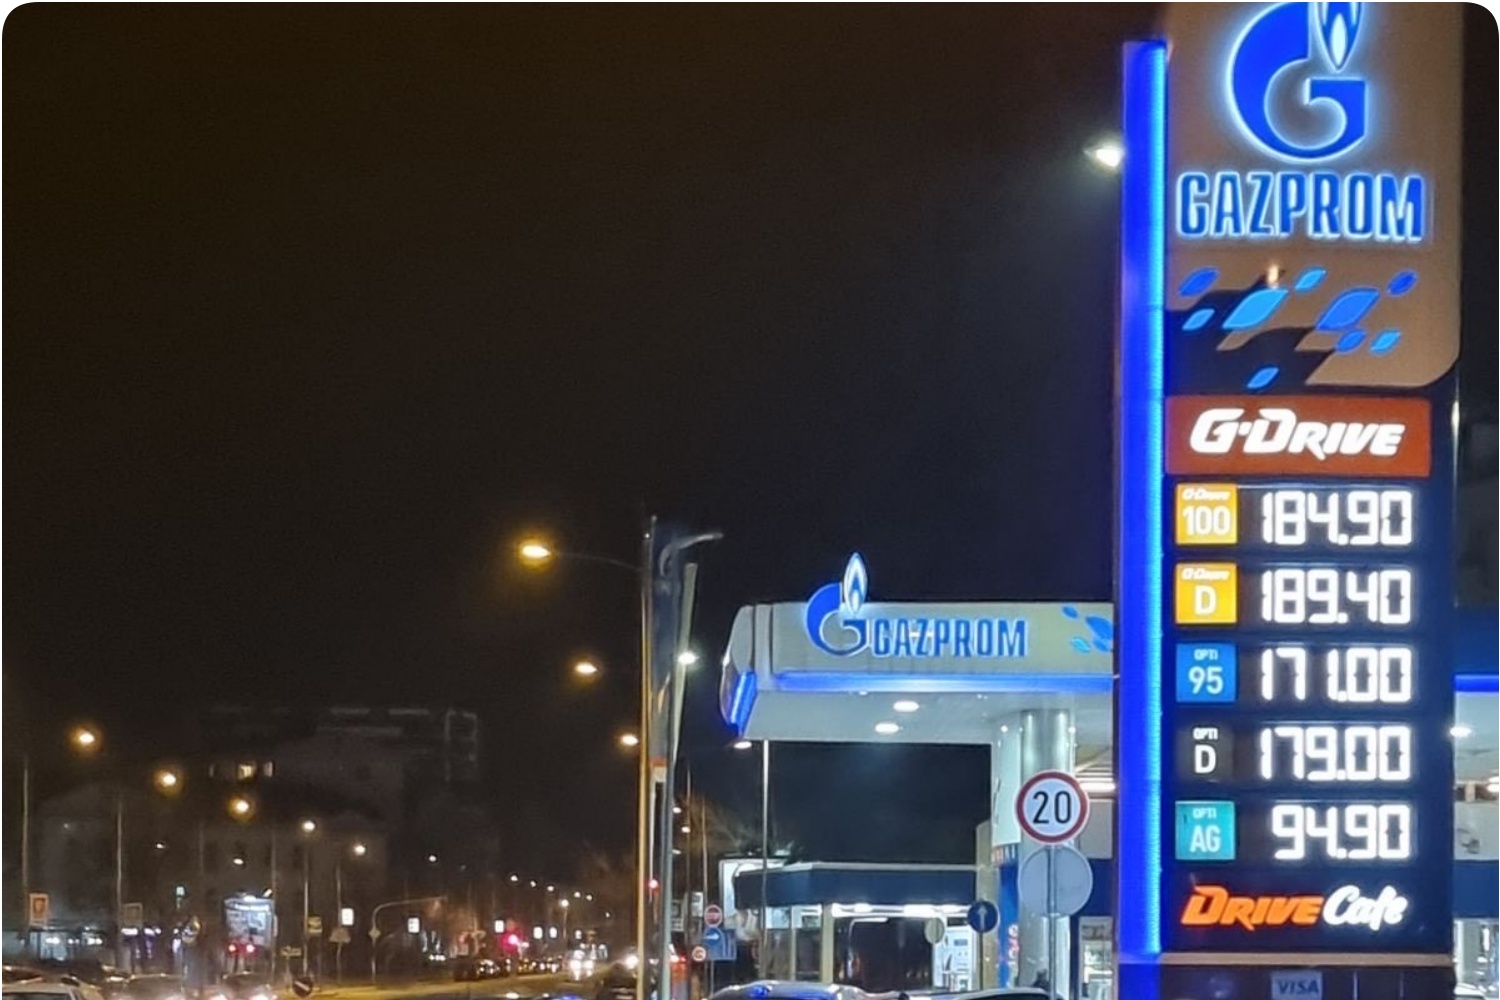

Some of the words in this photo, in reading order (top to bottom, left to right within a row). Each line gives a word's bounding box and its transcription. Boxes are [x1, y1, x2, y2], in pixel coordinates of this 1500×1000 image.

[1176, 171, 1426, 242] GAZPROM
[1182, 506, 1231, 535] 100
[1262, 490, 1412, 545] 184.90
[1194, 585, 1217, 614] D
[1262, 568, 1411, 624] 189.40
[872, 618, 1027, 658] GAZPROM
[1188, 666, 1223, 694] 95
[1262, 647, 1411, 702] 171.00
[1193, 727, 1218, 740] OPTI
[1194, 744, 1217, 773] D
[1260, 726, 1411, 781] 179.00
[1032, 790, 1072, 825] 20
[1190, 828, 1221, 852] AG
[1271, 804, 1411, 860] 94.90
[1193, 807, 1217, 819] OPTI
[1181, 885, 1324, 931] DRIVE
[1322, 885, 1408, 931] Cafe
[1277, 979, 1319, 994] VISA
